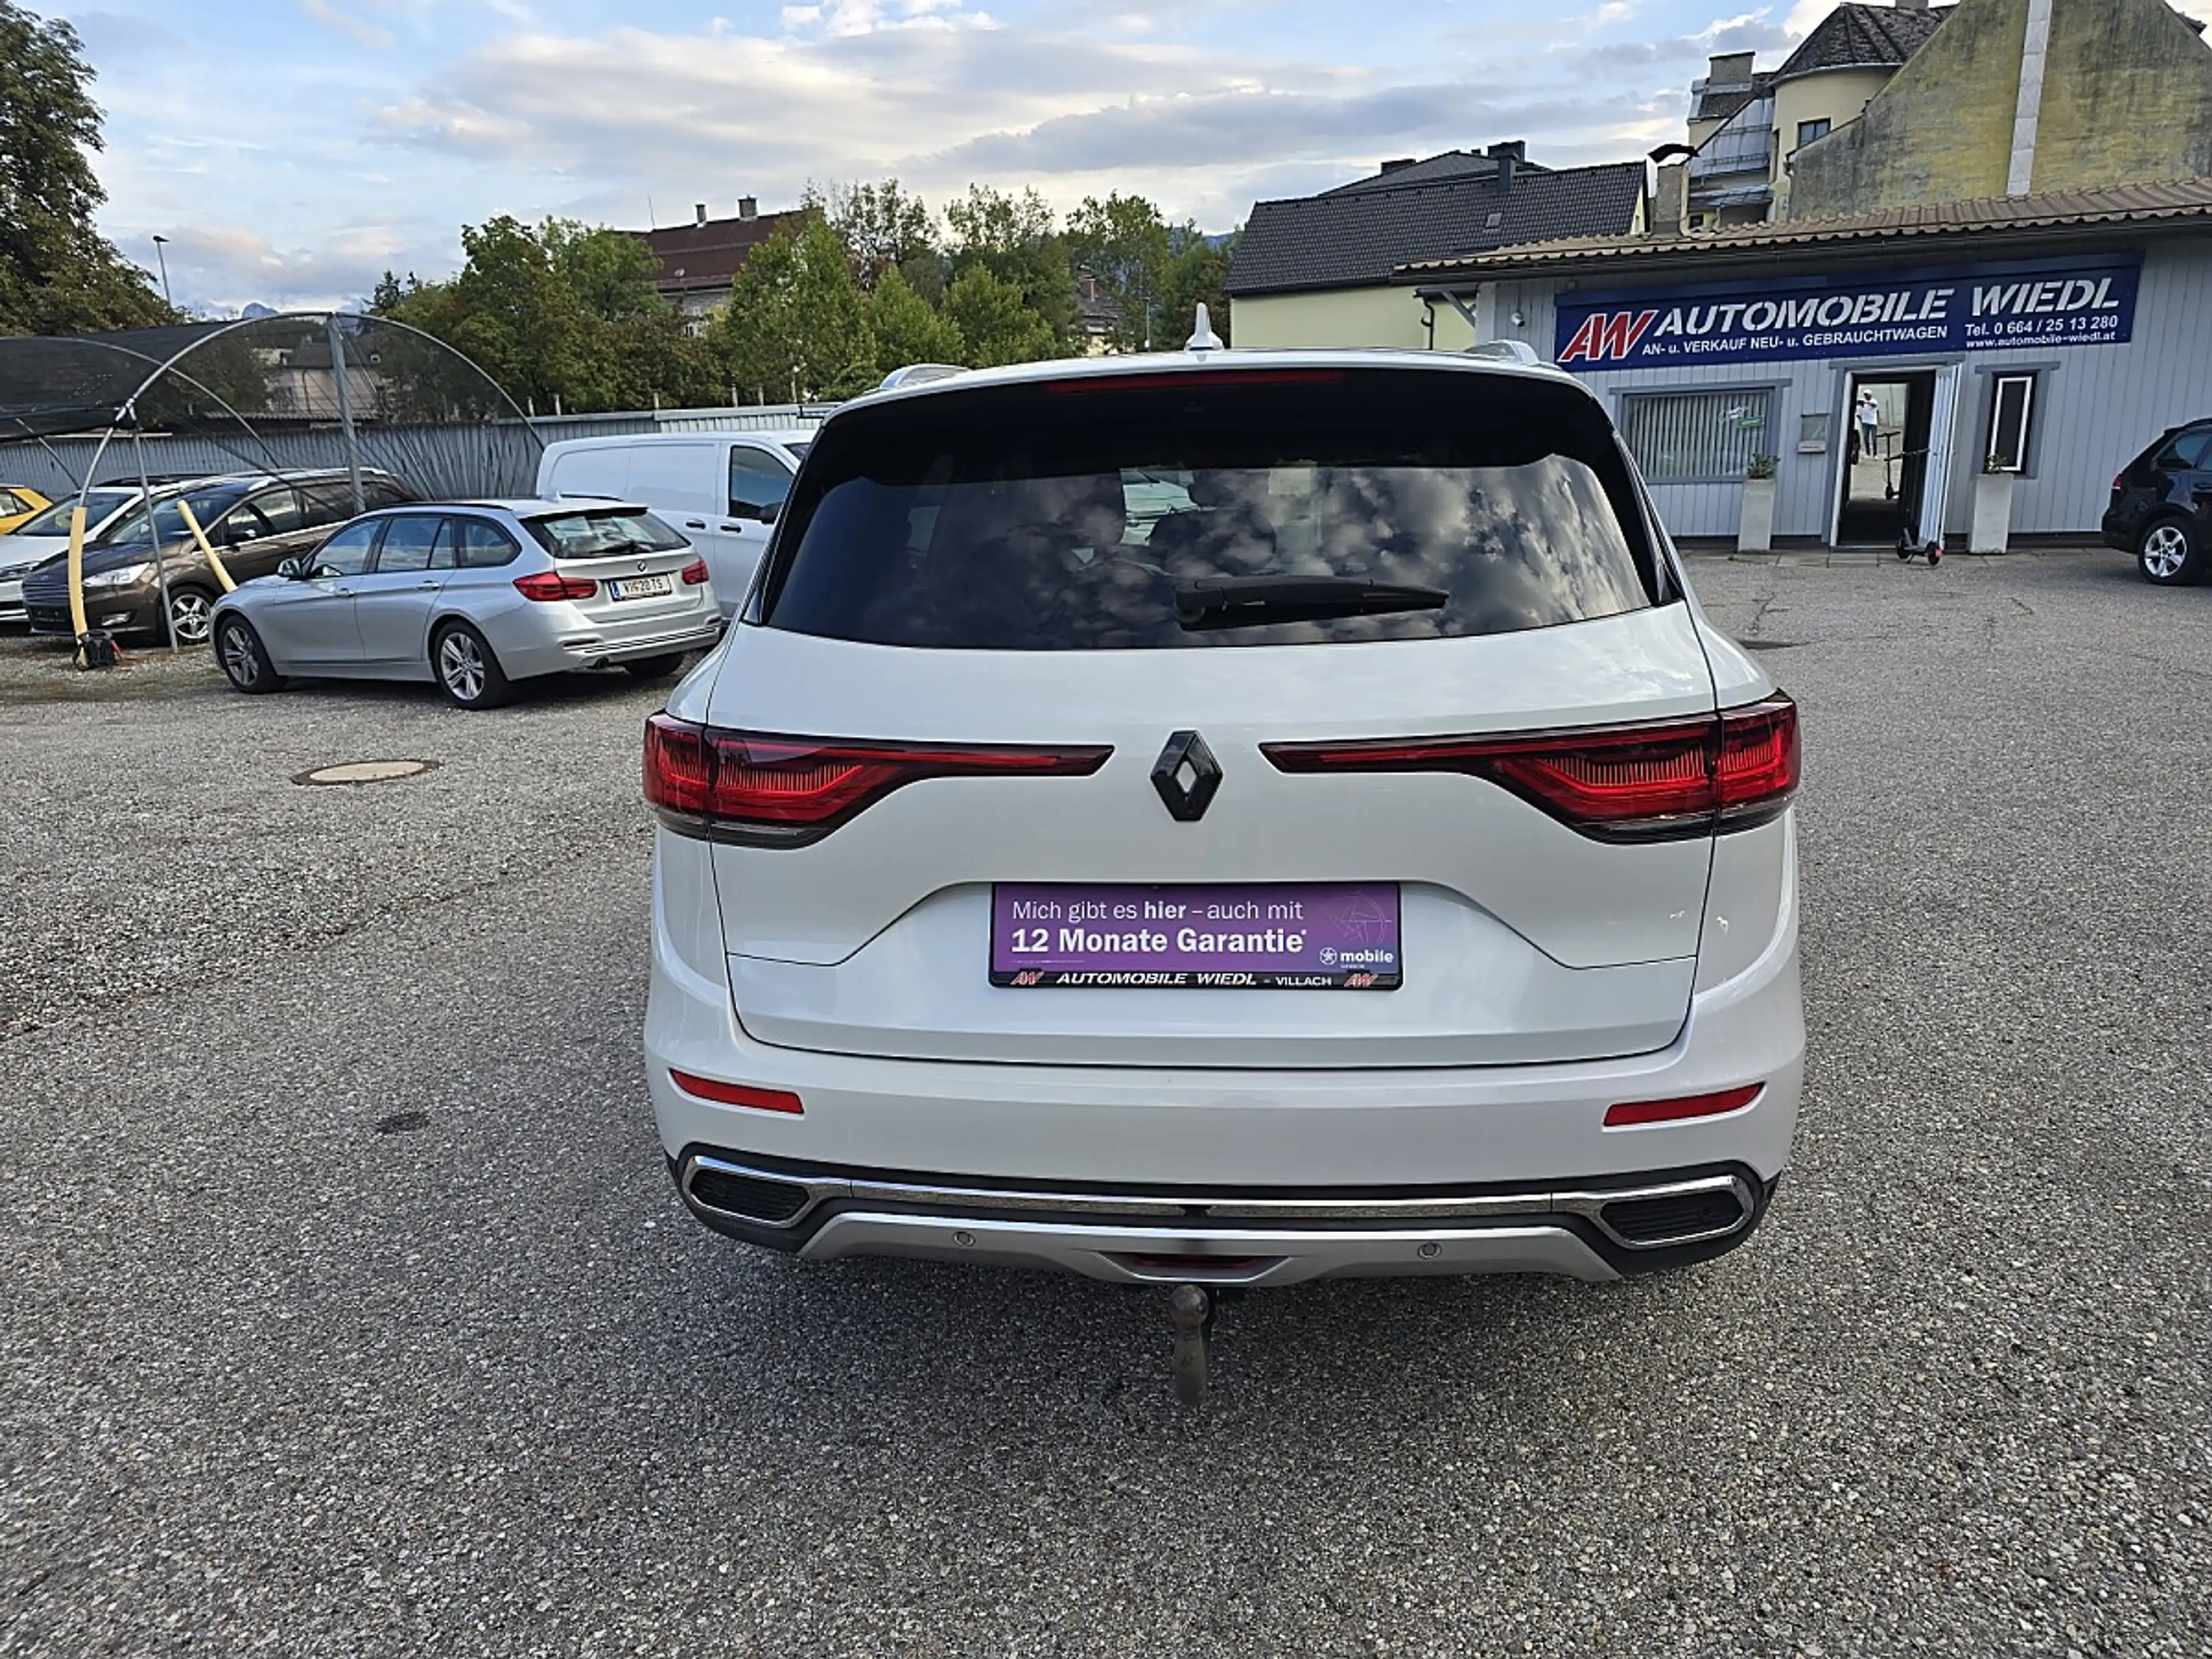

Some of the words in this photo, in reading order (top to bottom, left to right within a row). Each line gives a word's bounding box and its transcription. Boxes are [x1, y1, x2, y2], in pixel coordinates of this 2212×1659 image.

[1556, 309, 1660, 363] AW
[1653, 288, 1955, 337] AUTOMOBILE
[1971, 277, 2119, 317] WIEDL
[1965, 324, 1990, 336] Tel.
[1994, 323, 2003, 335] 0
[2007, 320, 2033, 334] 664
[2046, 319, 2063, 332] 25
[2070, 316, 2086, 331] 13
[2090, 315, 2119, 329] 280
[1642, 343, 1665, 355] AN-
[1668, 344, 1680, 354] u.
[1683, 338, 1747, 354] VERKAUF
[1750, 336, 1783, 349] NEU-
[1787, 338, 1798, 347] u.
[1802, 325, 1948, 346] GEBRAUCHTWAGEN
[1013, 901, 1061, 919] Mich
[1069, 901, 1107, 923] gibt
[1113, 904, 1138, 919] es
[1145, 900, 1186, 919] hier
[1207, 900, 1259, 919] auch
[1268, 901, 1304, 919] mit
[1012, 929, 1049, 952] 12
[1059, 929, 1168, 952] Monate
[1340, 949, 1394, 963] mobile
[1056, 973, 1188, 984] AUTOMOBILE
[1197, 973, 1257, 985] WIEDL
[1275, 976, 1332, 987] VILLACH
